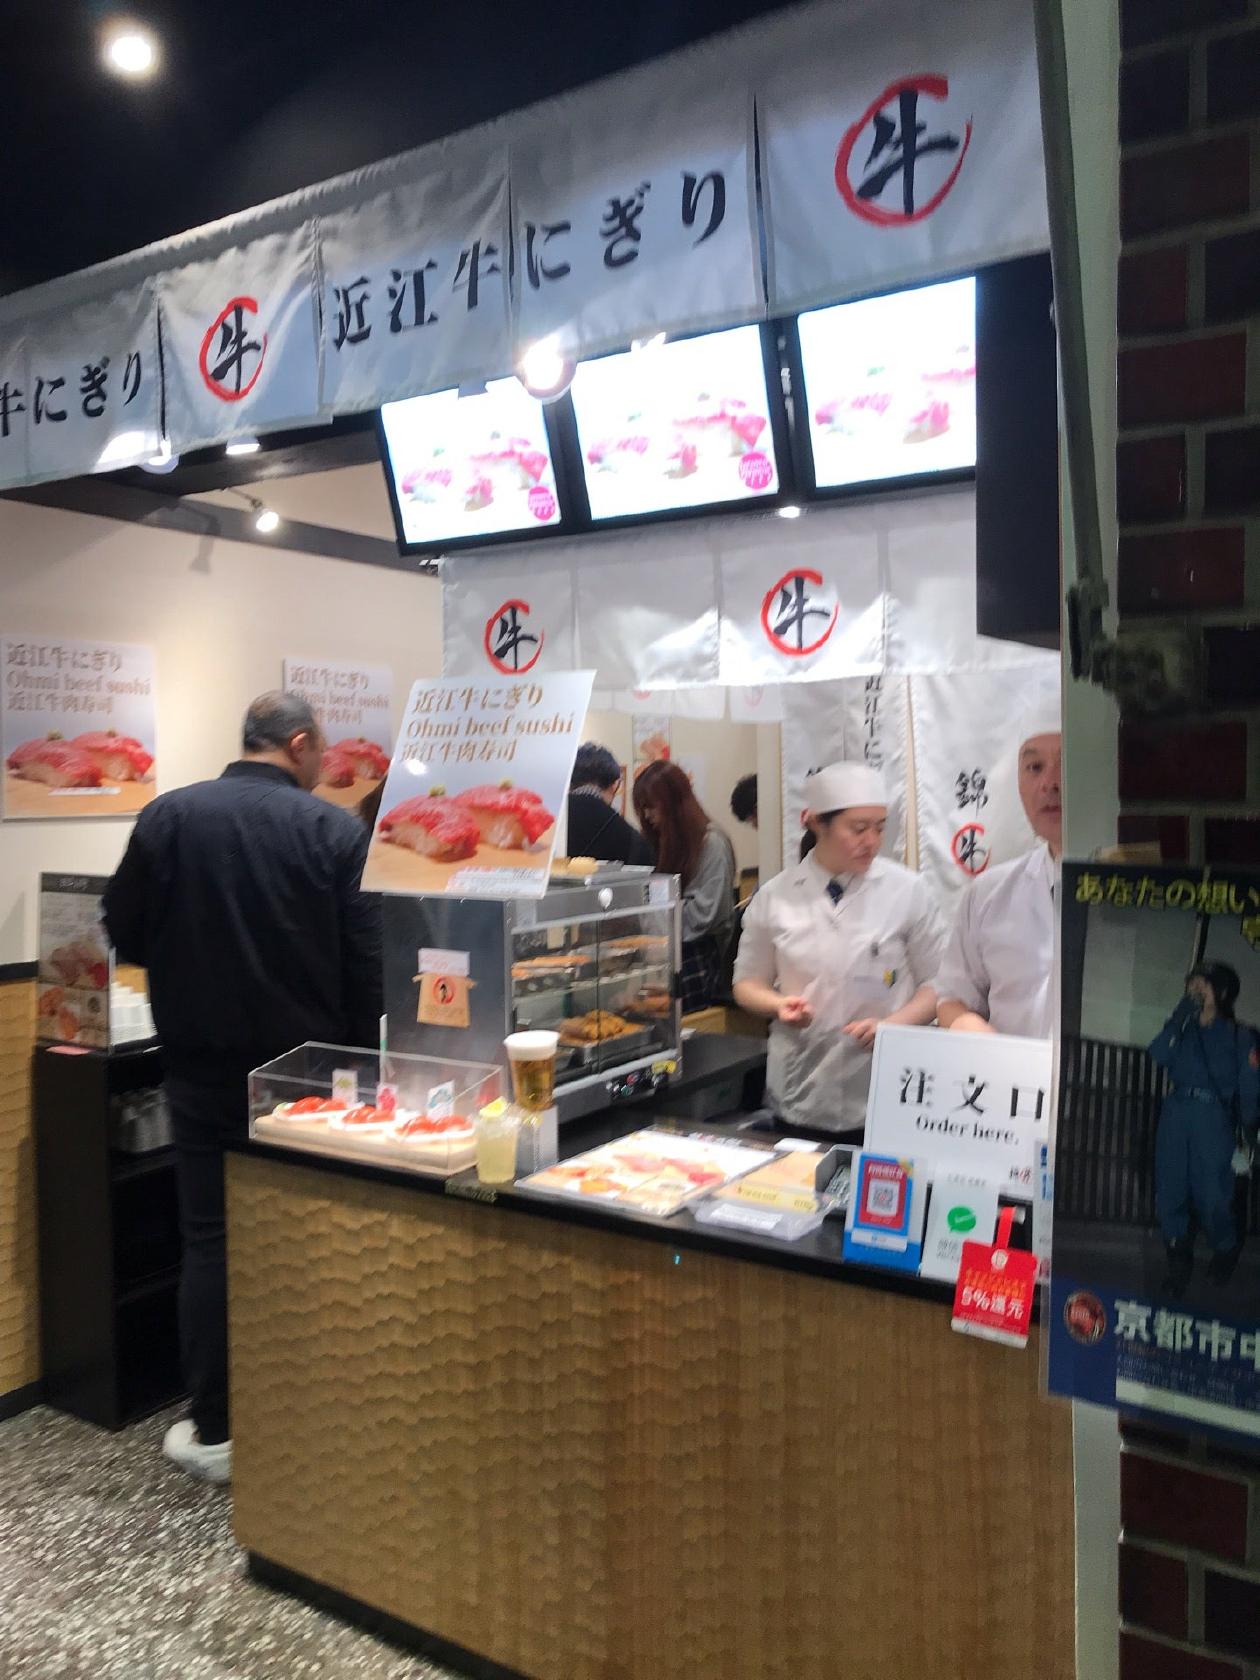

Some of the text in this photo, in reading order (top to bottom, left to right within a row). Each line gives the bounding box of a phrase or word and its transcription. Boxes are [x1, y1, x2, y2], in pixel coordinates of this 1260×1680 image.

[856, 88, 960, 216] 牛
[332, 170, 727, 353] 近江牛にぎり
[211, 304, 262, 394] 牛
[493, 606, 539, 671] 牛
[774, 576, 831, 651] 牛
[64, 673, 104, 692] beef
[106, 676, 152, 695] sushi
[412, 682, 544, 714] 近江牛にぎり
[406, 711, 576, 738] Ohmi beef sushi
[916, 1113, 968, 1137] Order
